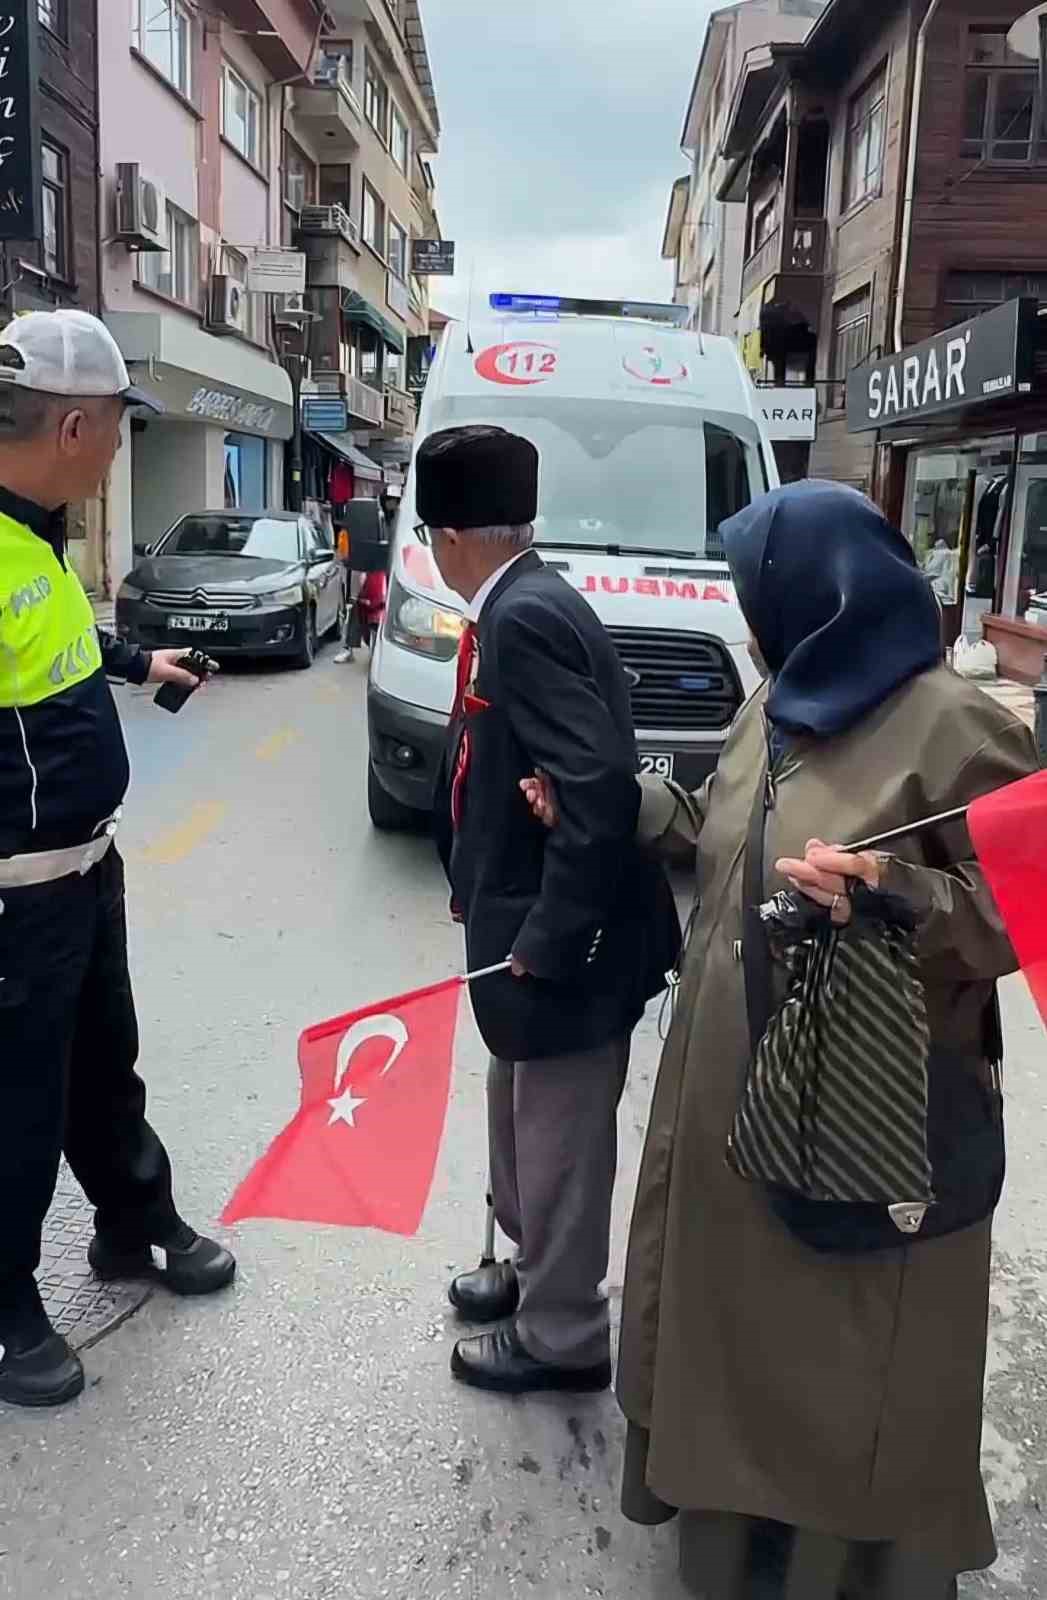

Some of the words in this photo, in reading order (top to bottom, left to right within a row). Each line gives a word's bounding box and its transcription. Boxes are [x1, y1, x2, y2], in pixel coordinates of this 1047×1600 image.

[508, 353, 556, 373] 112
[868, 335, 968, 419] SARAR
[641, 756, 669, 777] 29
